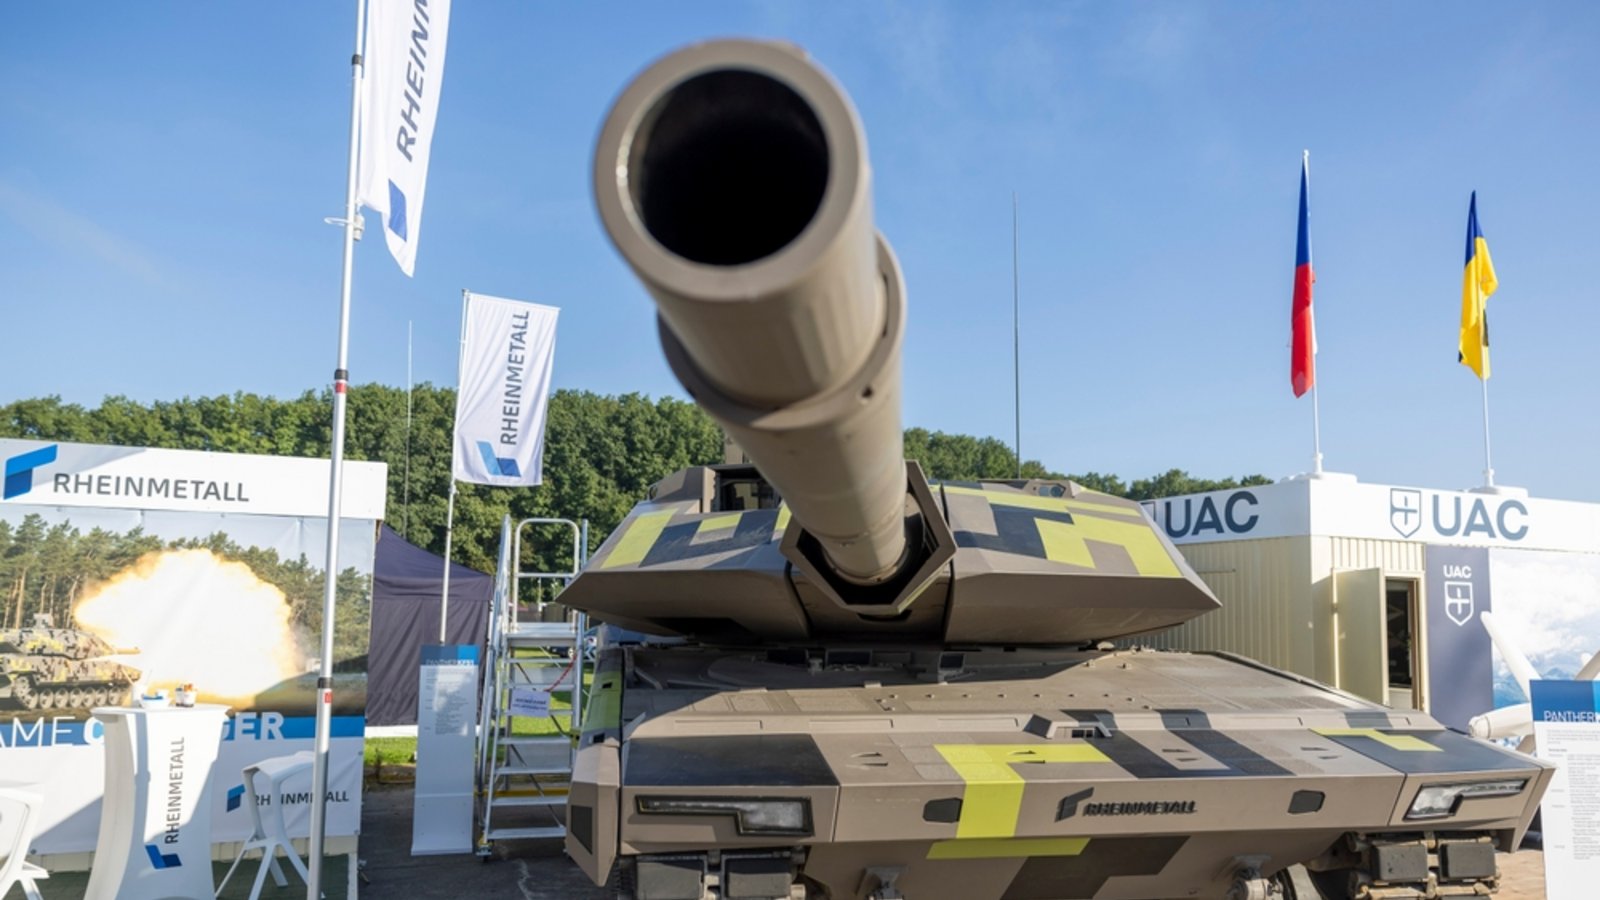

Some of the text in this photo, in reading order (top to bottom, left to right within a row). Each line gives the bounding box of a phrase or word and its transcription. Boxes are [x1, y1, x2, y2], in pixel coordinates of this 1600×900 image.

[500, 311, 529, 446] RHEINMETALL
[53, 472, 250, 502] RHEINMETALL
[1165, 491, 1259, 538] UAC
[1432, 494, 1529, 541] UAC
[1443, 565, 1472, 579] UAC
[0, 716, 76, 748] ME
[164, 736, 185, 845] RHEINMETALL
[1083, 800, 1198, 817] RHEINMETALL
